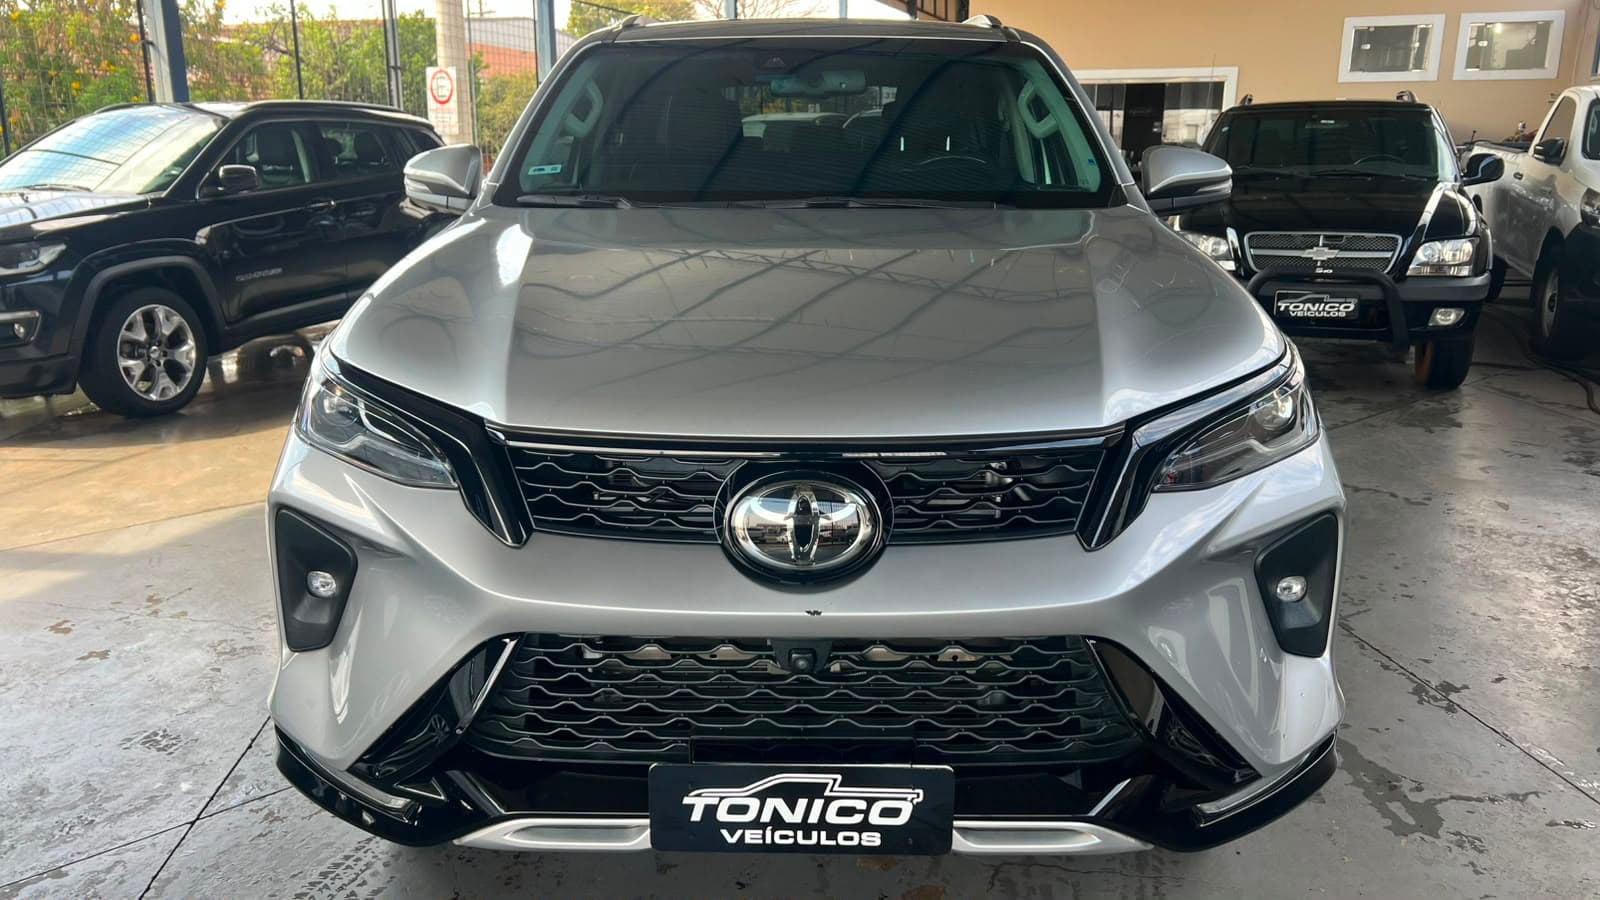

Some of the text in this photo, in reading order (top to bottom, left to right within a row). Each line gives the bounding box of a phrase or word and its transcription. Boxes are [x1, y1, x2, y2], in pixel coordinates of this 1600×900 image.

[1278, 302, 1355, 312] TONICO
[682, 796, 914, 826] TONICO
[720, 826, 882, 847] VEÍCULOS
